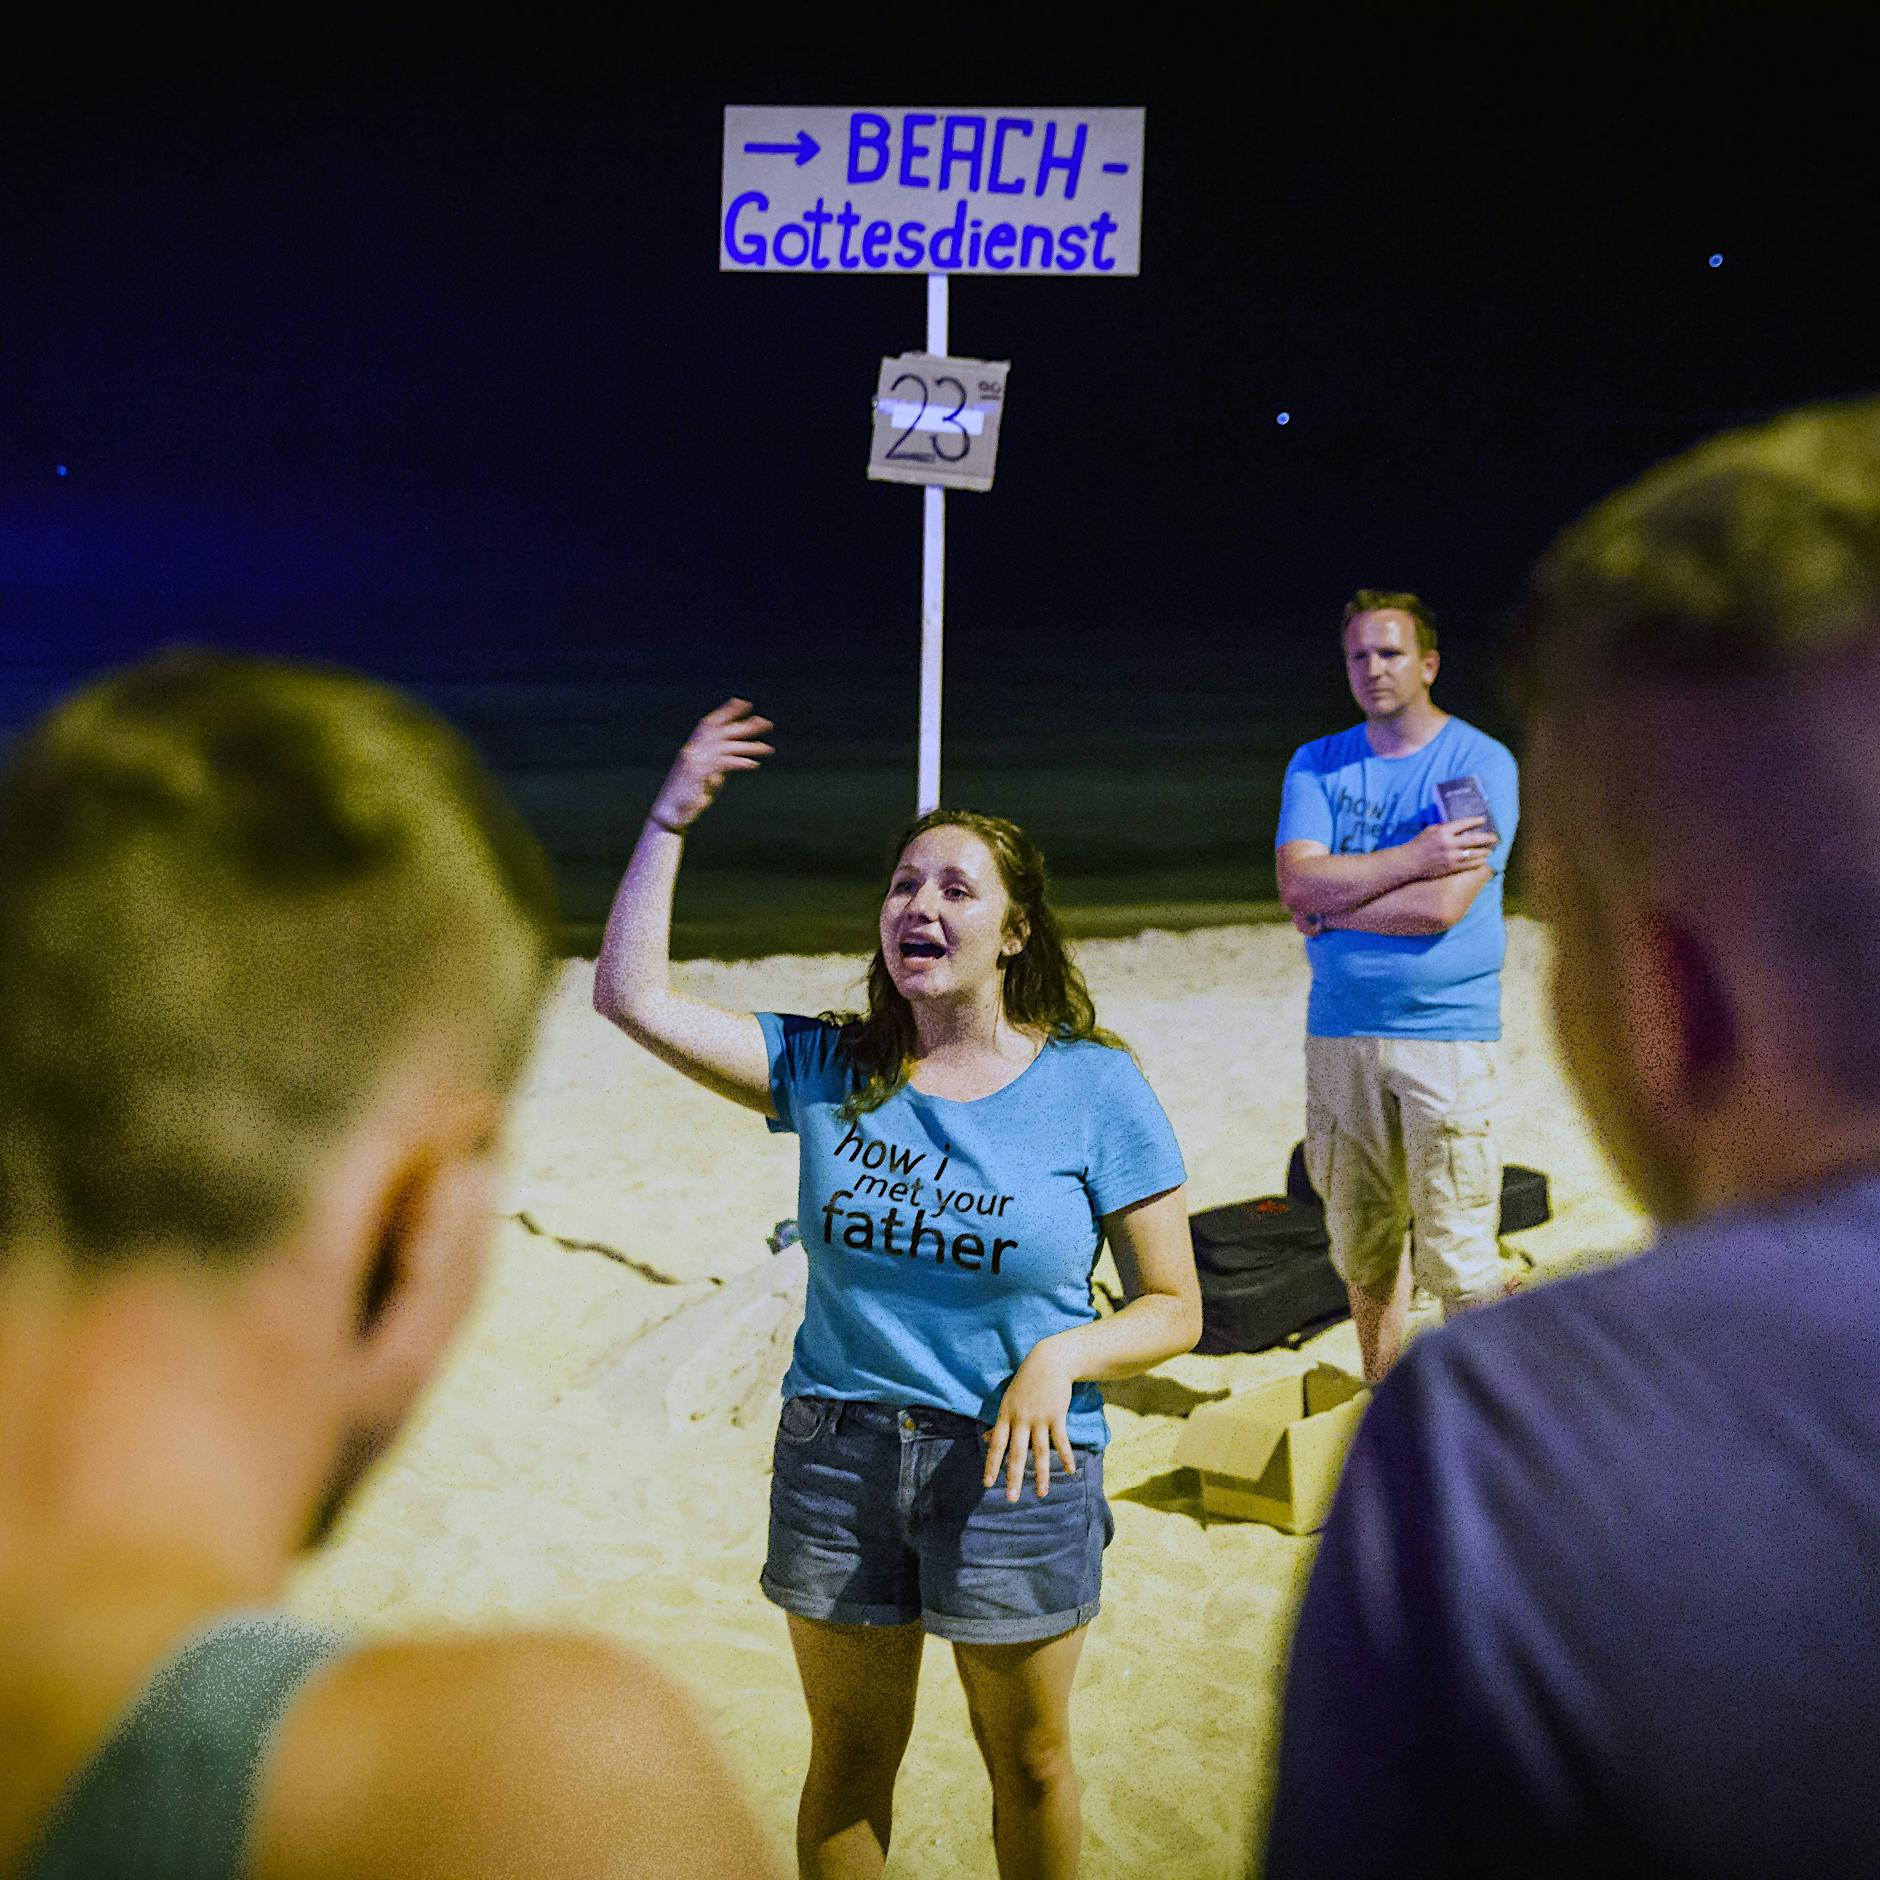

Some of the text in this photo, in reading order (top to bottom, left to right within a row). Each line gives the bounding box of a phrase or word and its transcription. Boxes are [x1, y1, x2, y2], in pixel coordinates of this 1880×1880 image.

[724, 190, 1118, 271] Gottesdienst
[885, 373, 971, 463] 23
[833, 1119, 928, 1176] how
[822, 1189, 1019, 1275] father
[853, 1174, 1015, 1219] met your
